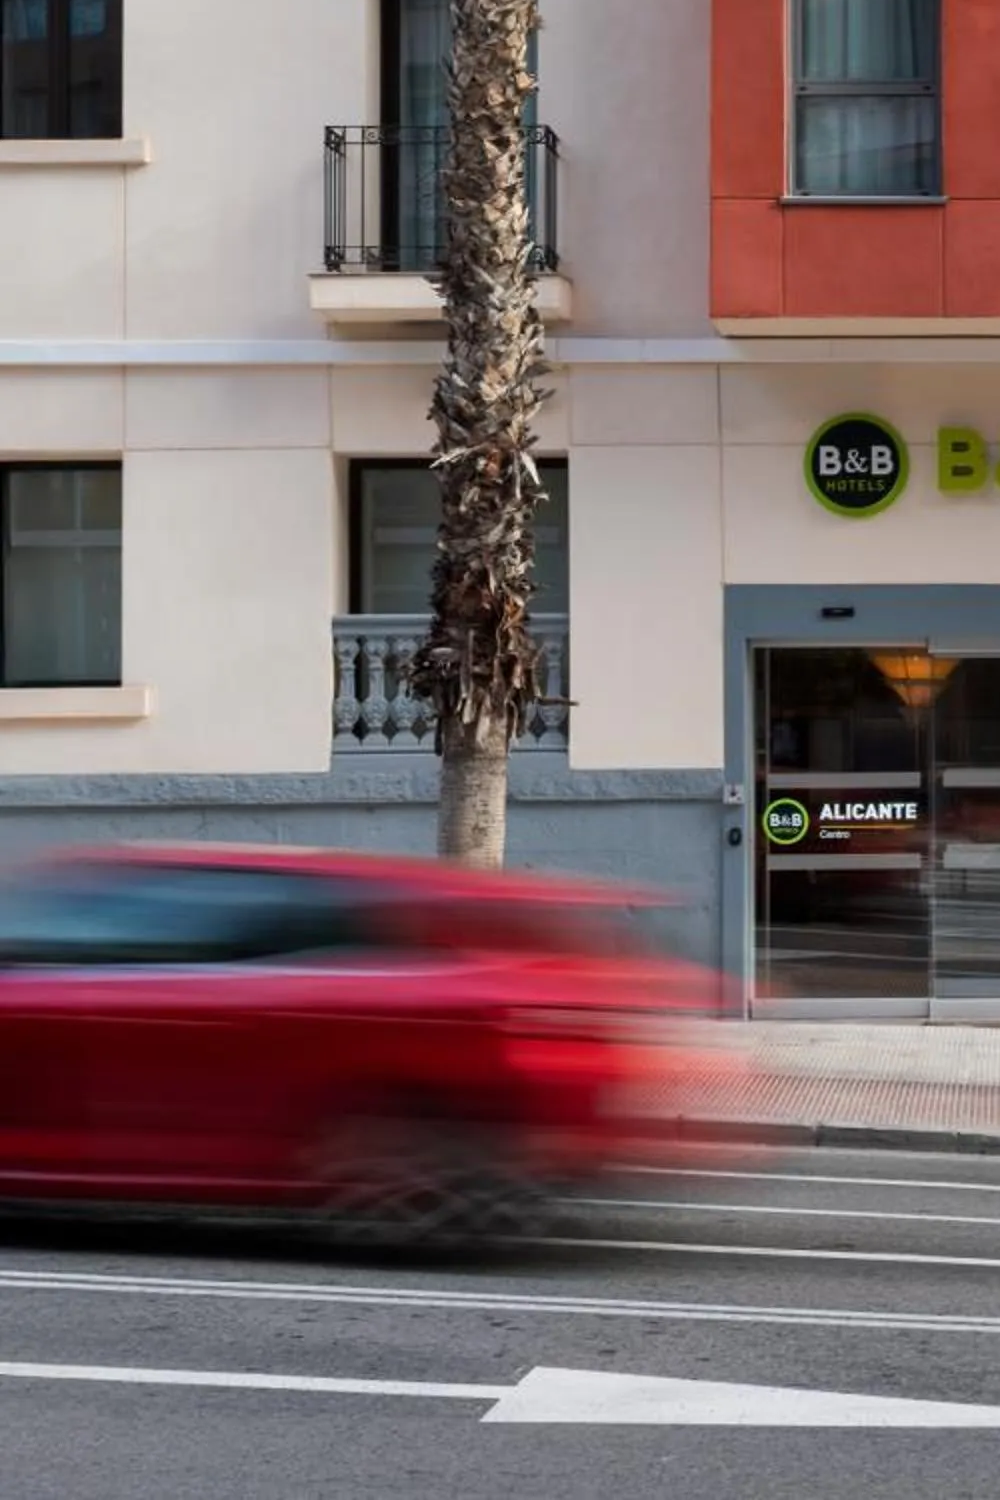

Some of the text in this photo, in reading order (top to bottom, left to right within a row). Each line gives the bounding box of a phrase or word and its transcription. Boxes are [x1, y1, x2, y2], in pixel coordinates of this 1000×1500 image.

[819, 445, 894, 475] B&B
[826, 480, 885, 491] HOTELS
[820, 803, 917, 820] ALICANTE
[769, 813, 802, 827] B&B
[819, 830, 850, 839] Centro
